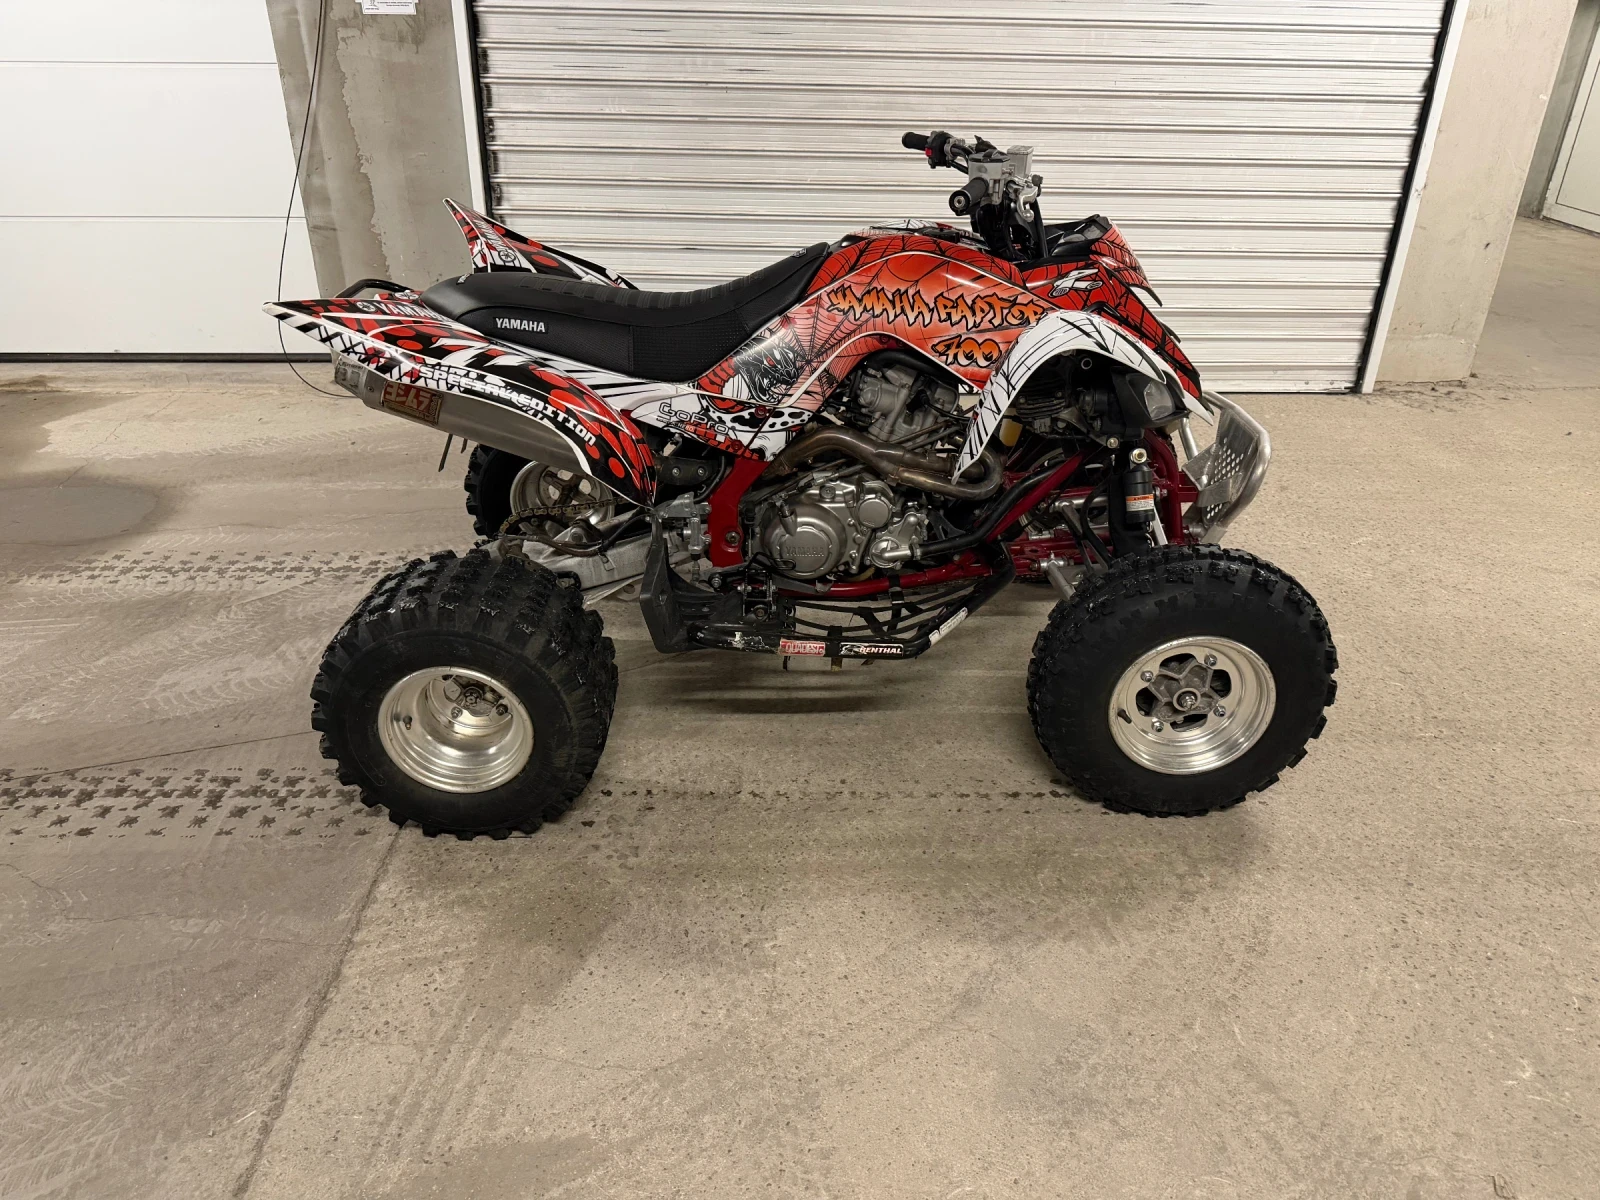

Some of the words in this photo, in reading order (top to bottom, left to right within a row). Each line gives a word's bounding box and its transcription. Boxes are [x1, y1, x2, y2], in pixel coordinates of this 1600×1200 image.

[827, 284, 934, 328] YAMAHA
[934, 292, 1046, 331] RAPTOR
[495, 317, 546, 333] YAMAHA
[931, 334, 1003, 368] 700
[419, 366, 512, 400] SPECIAL
[518, 393, 597, 446] EDITION
[659, 402, 729, 434] GoPro
[859, 645, 903, 654] RENTHAL
